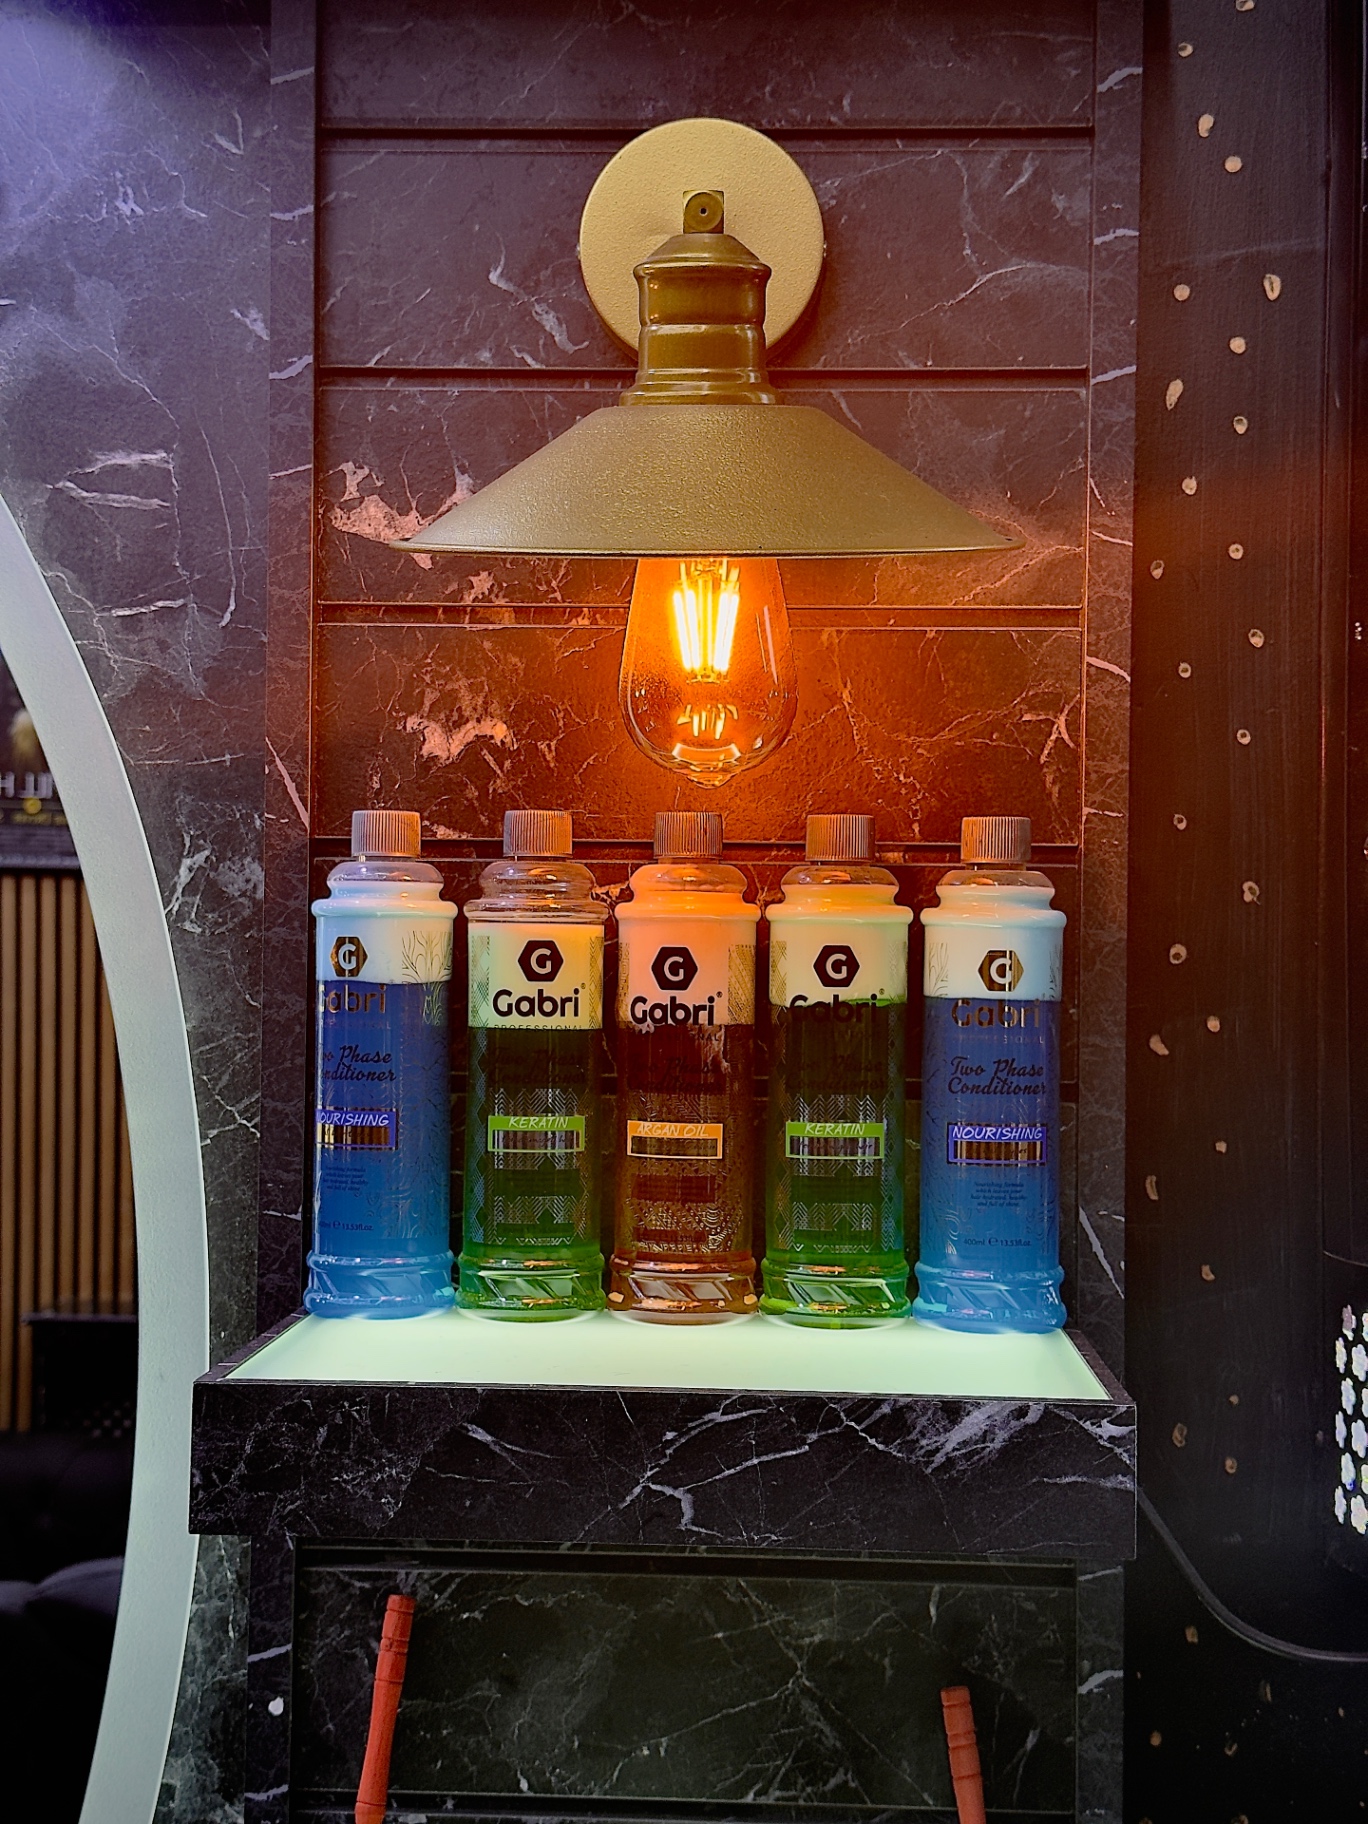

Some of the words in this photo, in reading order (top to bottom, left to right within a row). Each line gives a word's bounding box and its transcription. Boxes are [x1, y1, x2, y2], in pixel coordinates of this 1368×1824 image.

[531, 948, 552, 975] G
[664, 956, 684, 982] G
[826, 953, 848, 980] G
[493, 988, 580, 1018] Gabri
[630, 995, 715, 1026] Gabri
[951, 998, 1040, 1028] Gabri
[340, 1045, 393, 1064] Phase
[950, 1056, 986, 1076] Two
[993, 1058, 1044, 1078] Phase
[948, 1076, 1047, 1096] Conditioner
[508, 1116, 569, 1129] KERATIN
[636, 1122, 680, 1137] ARGAN
[683, 1124, 709, 1138] OIL
[804, 1123, 866, 1136] KERATIN
[952, 1125, 1043, 1140] NOURISHING
